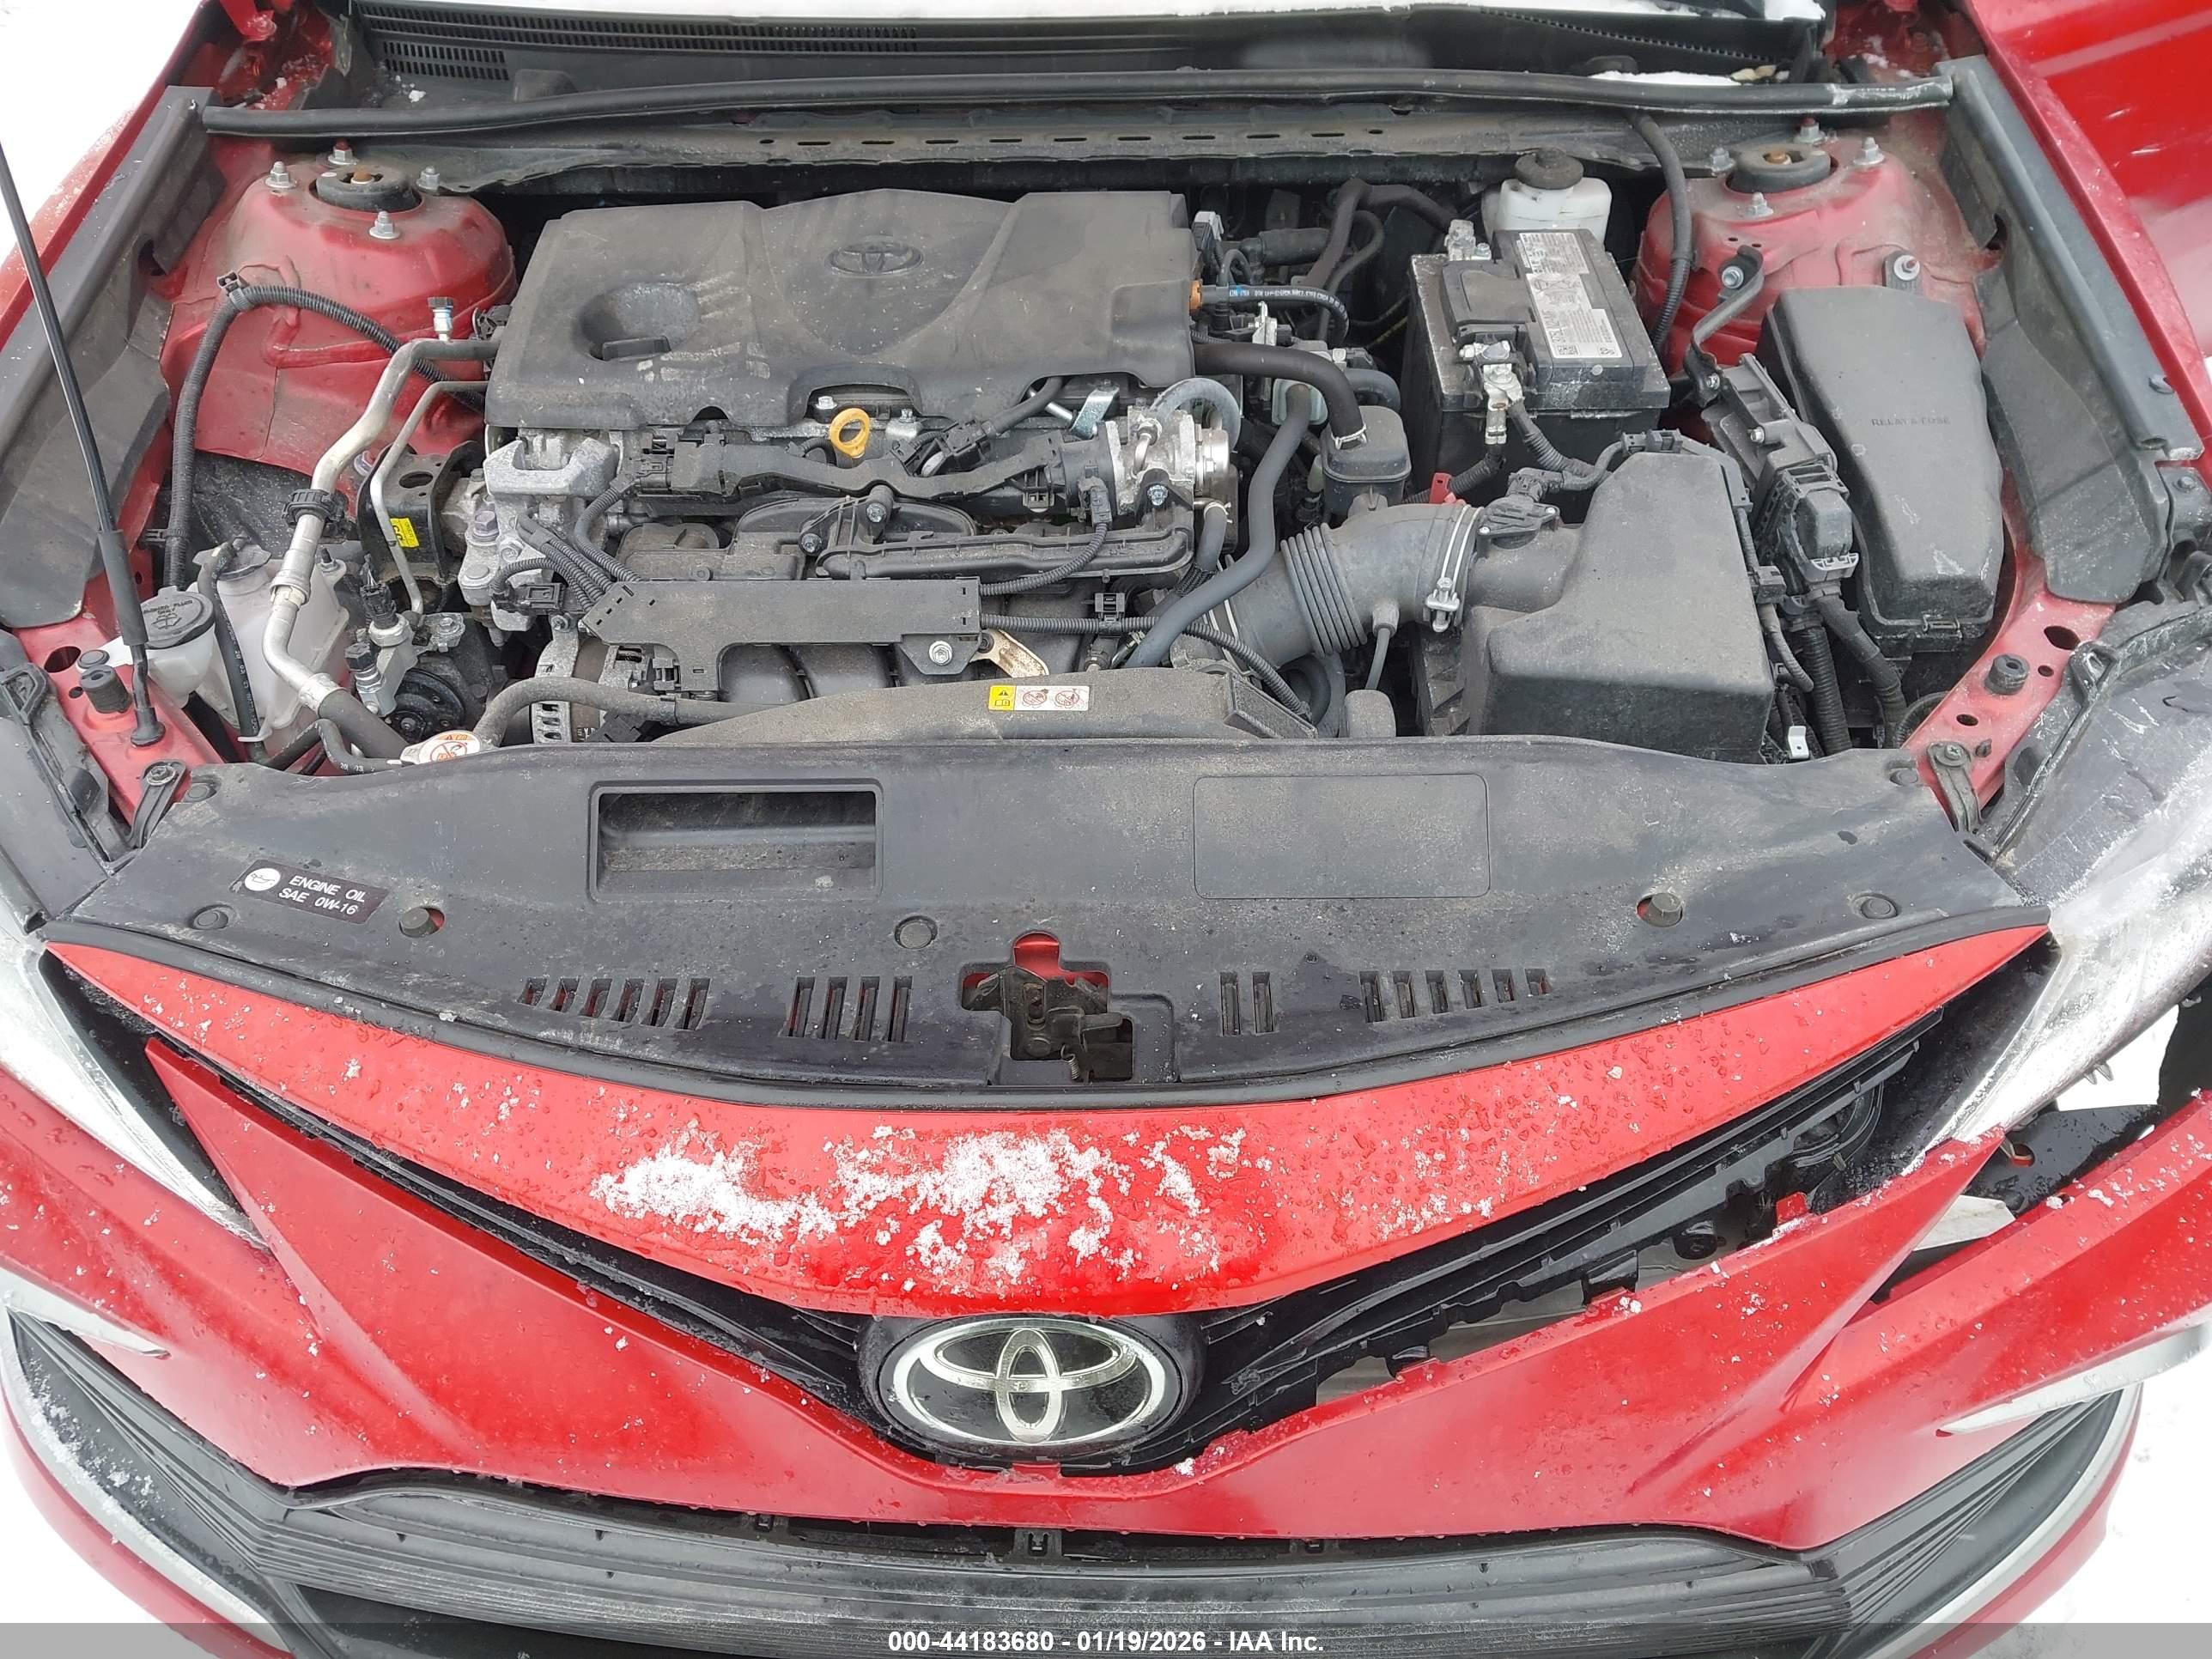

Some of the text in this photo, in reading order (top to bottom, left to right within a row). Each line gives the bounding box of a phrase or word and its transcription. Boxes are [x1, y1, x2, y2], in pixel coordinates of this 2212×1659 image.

[278, 887, 359, 915] SAE 0W-16
[289, 875, 368, 902] ENGINE OIL
